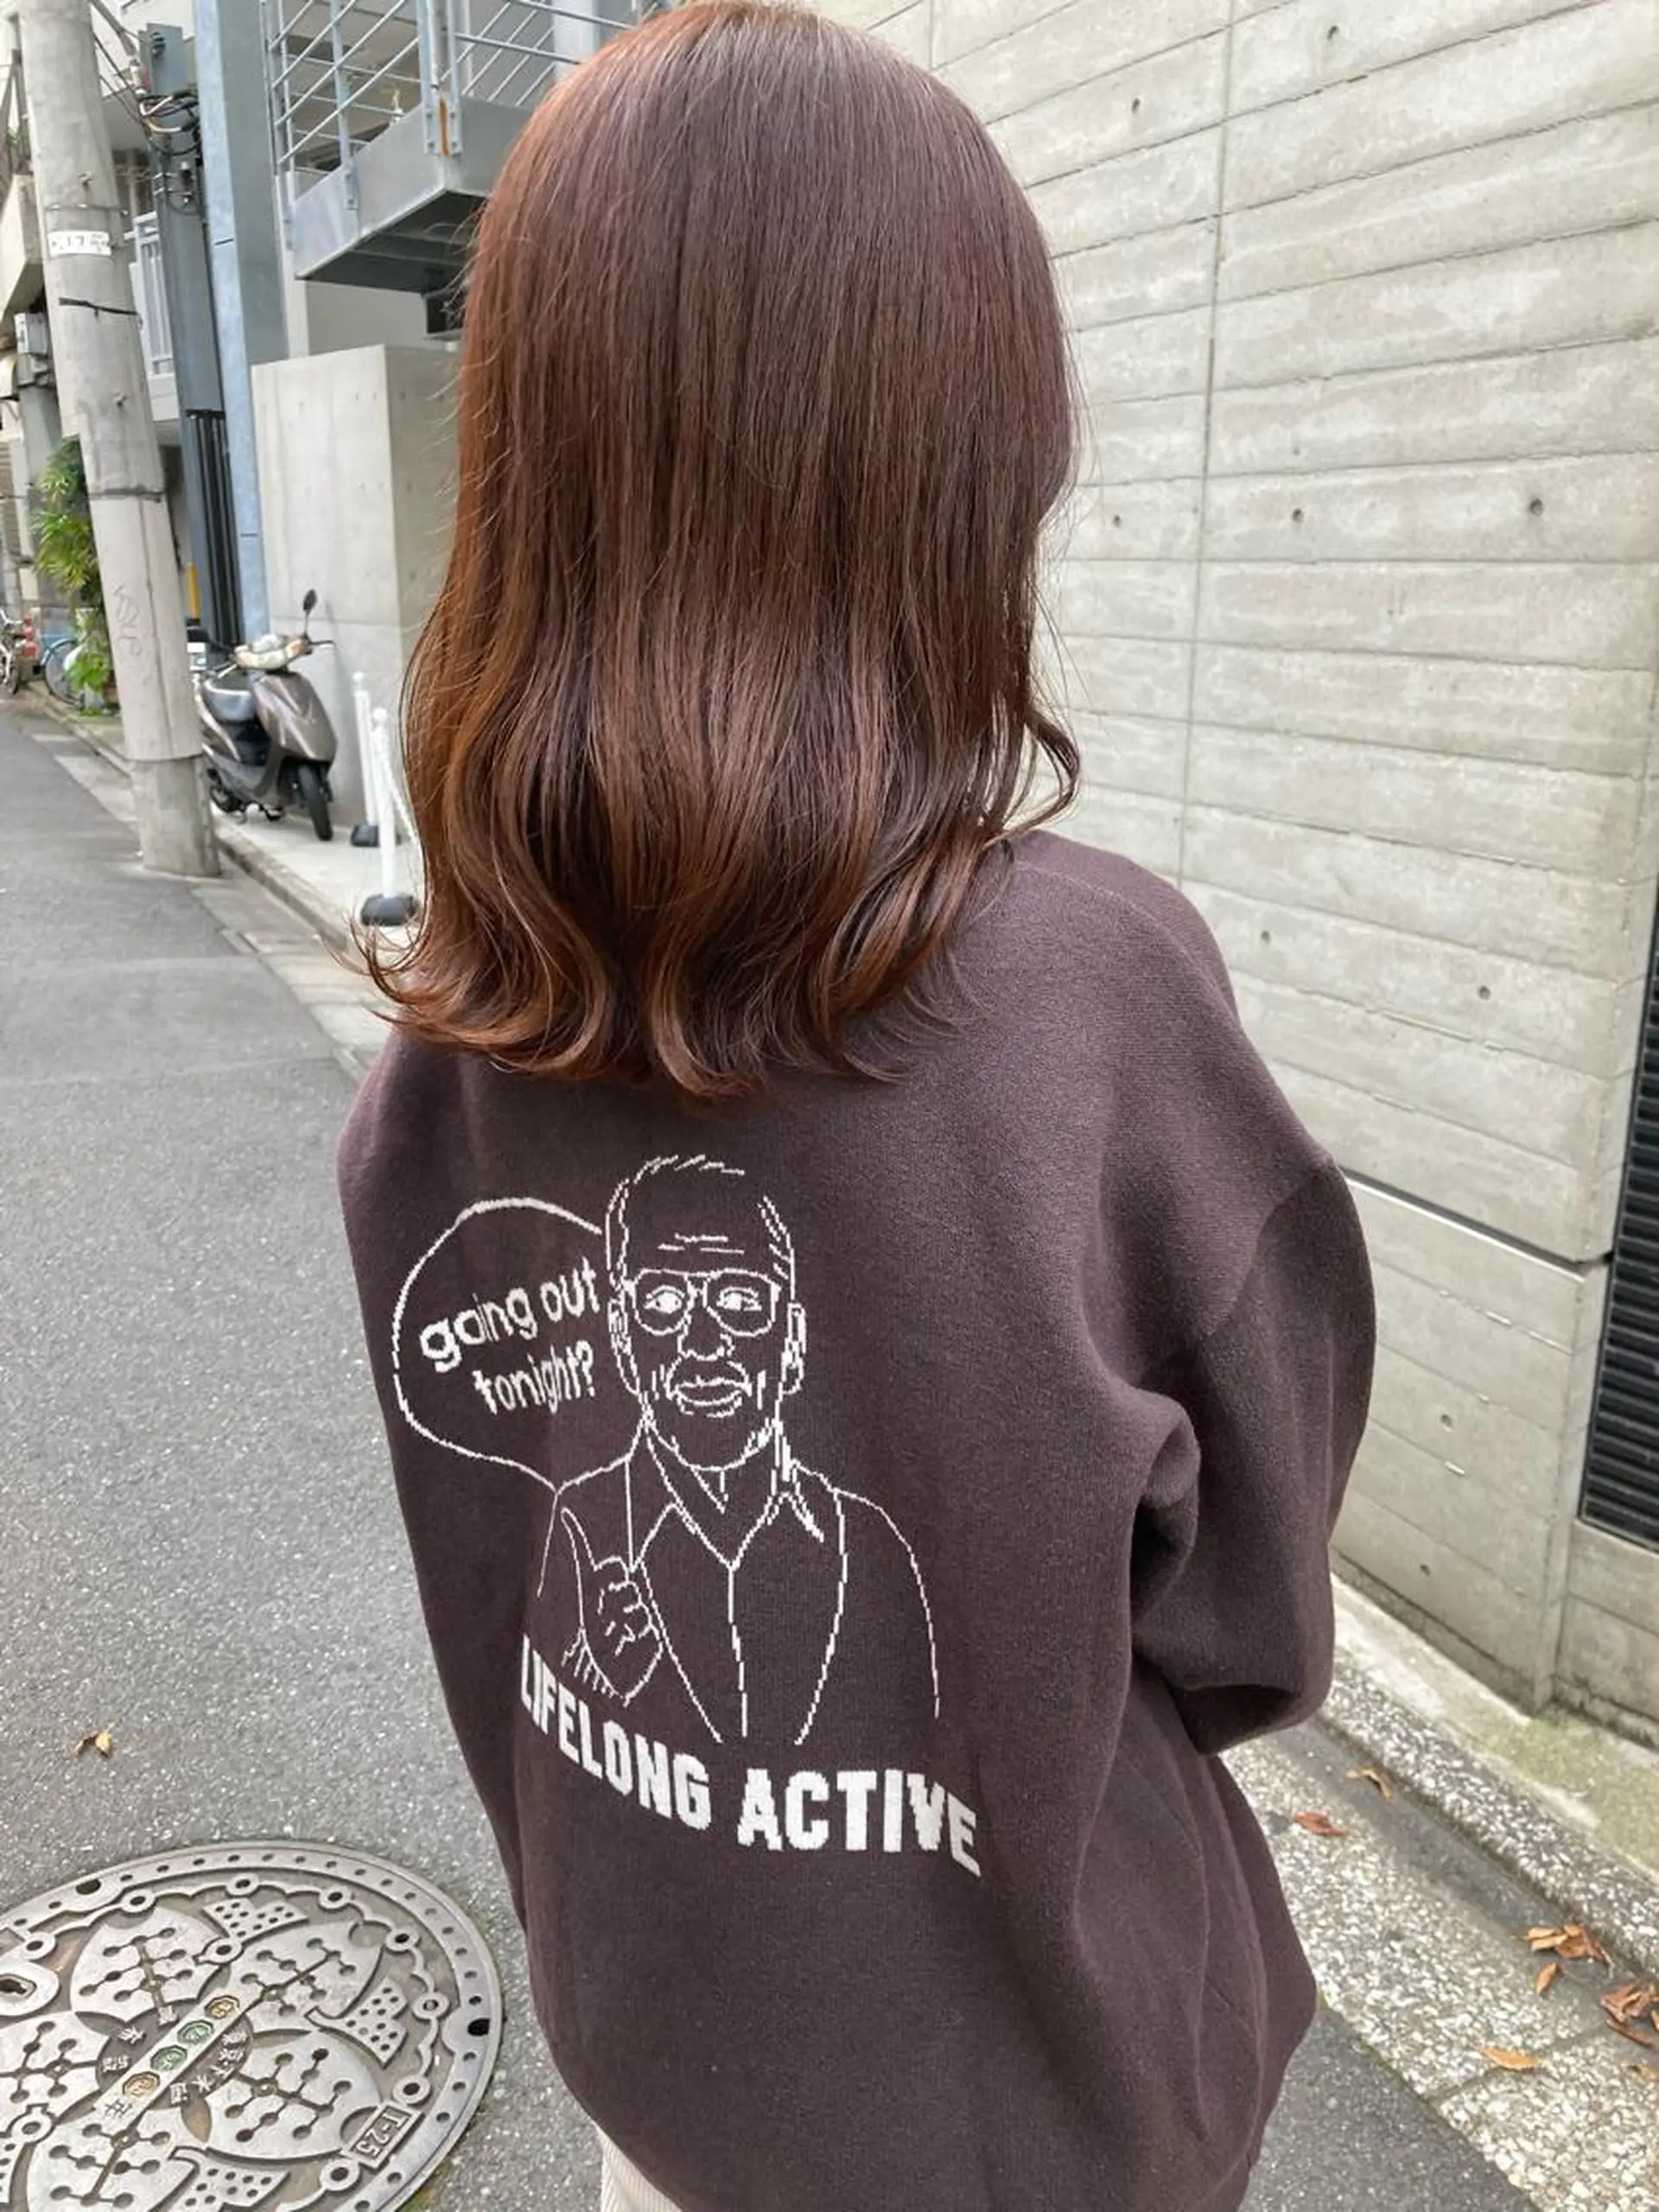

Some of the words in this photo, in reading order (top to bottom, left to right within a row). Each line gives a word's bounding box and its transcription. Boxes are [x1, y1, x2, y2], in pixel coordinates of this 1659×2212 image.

[419, 1288, 538, 1373] going
[540, 1255, 601, 1323] out
[472, 1339, 596, 1414] tonight?
[520, 1635, 712, 1831] LIFELONG
[736, 1768, 982, 1878] ACTIVE
[355, 2113, 409, 2157] T-25
